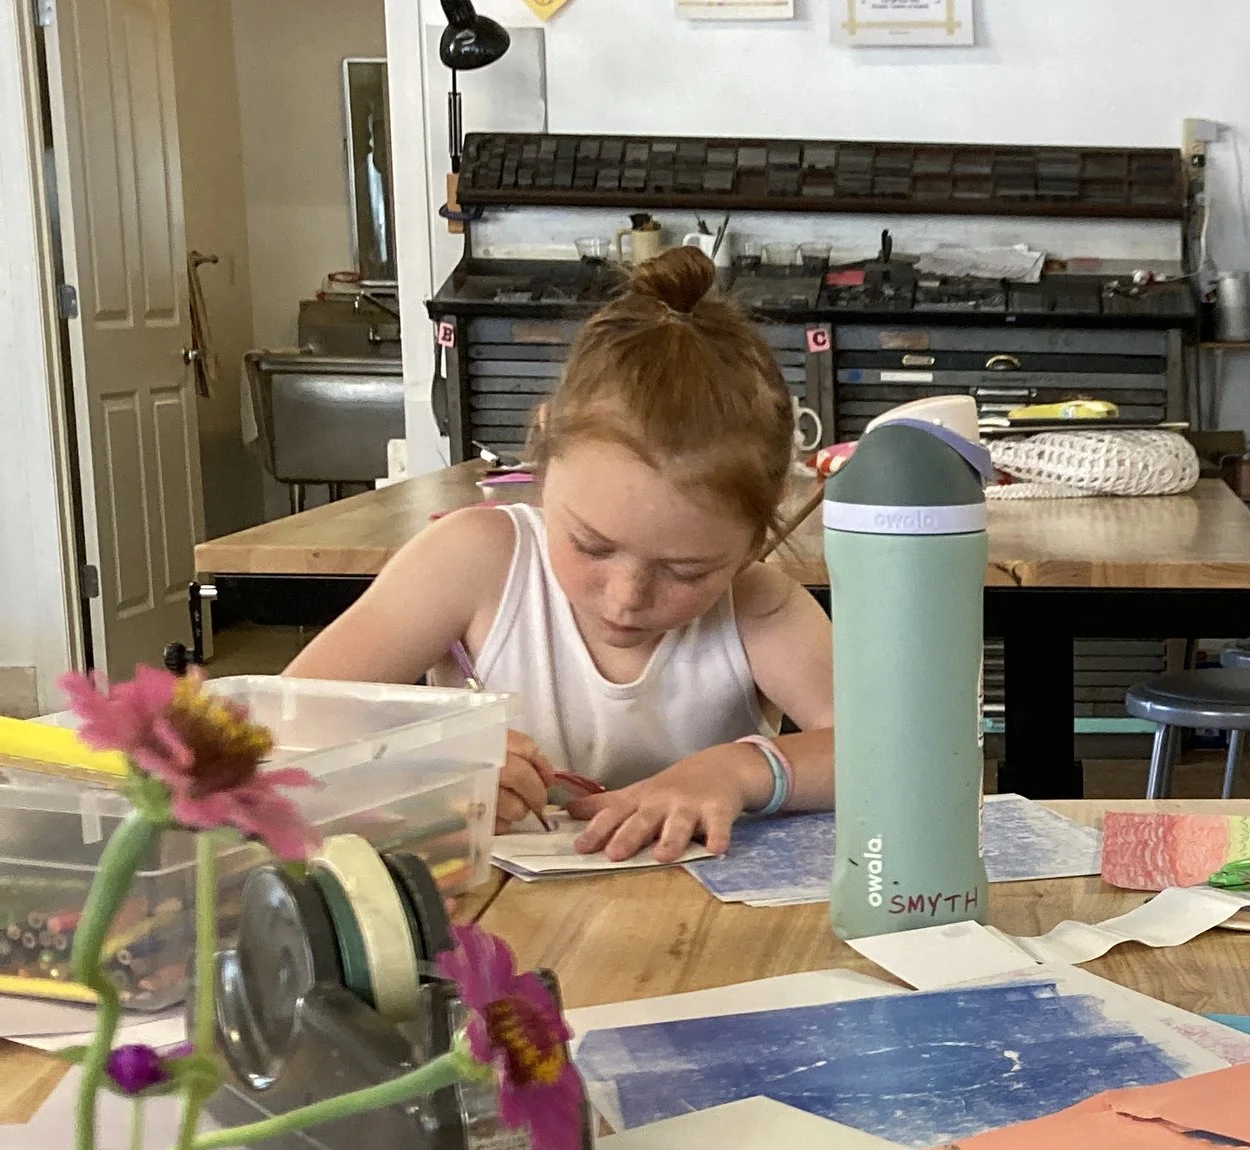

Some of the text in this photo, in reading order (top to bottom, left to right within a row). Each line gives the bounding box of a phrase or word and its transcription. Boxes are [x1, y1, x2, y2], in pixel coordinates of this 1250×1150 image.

[442, 326, 453, 342] B
[812, 331, 827, 347] C
[863, 838, 883, 907] owala
[888, 886, 978, 917] SMYTH
